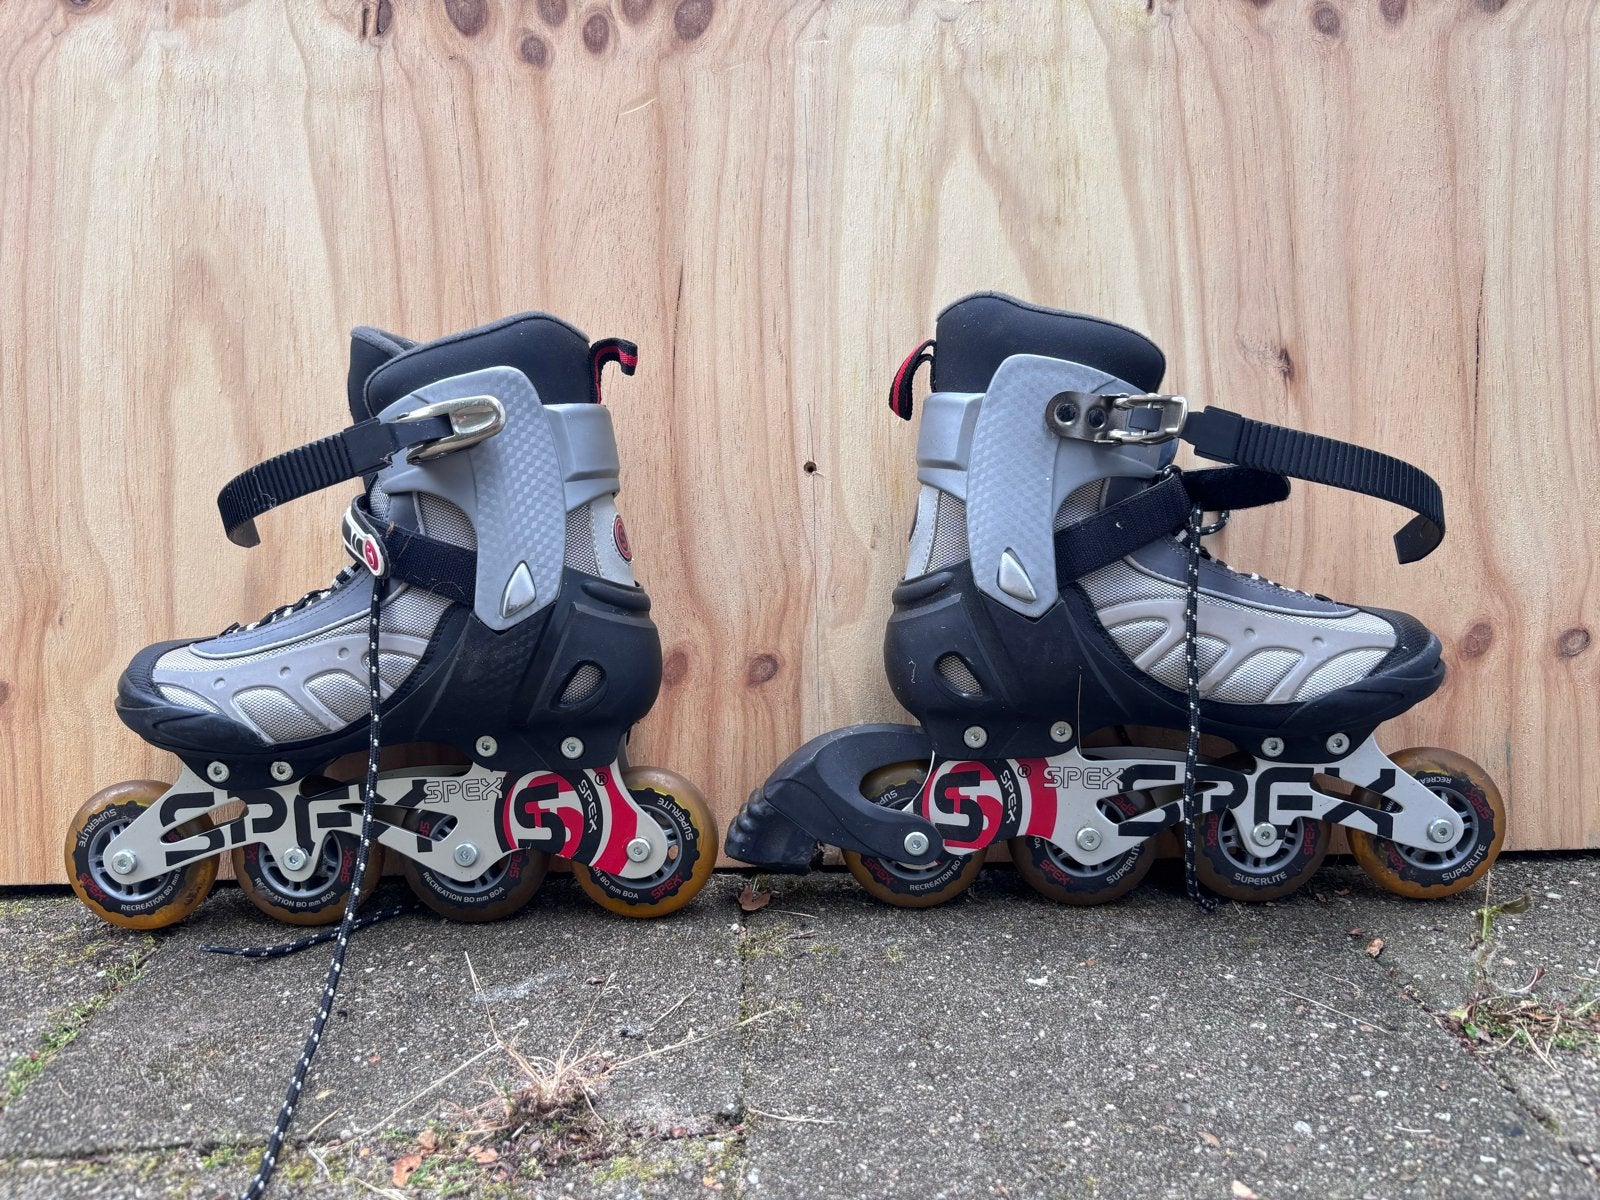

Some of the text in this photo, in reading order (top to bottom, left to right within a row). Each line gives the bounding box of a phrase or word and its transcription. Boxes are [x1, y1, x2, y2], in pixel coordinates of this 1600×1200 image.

[423, 777, 504, 804] SPEX
[1042, 766, 1127, 790] SPEX
[577, 778, 599, 834] SPEX
[1000, 769, 1017, 824] SPEX
[1112, 795, 1137, 816] SPE
[78, 808, 118, 848] SUPERLITE
[657, 797, 694, 841] SUPERLITE
[1303, 822, 1316, 856] SPEX
[340, 848, 354, 884] SPEX
[509, 852, 524, 879] SPE
[863, 858, 894, 885] SPEX
[1040, 859, 1070, 886] SPEX
[1442, 843, 1487, 881] SUPERLITE
[80, 872, 108, 901] SPEX
[422, 871, 463, 902] RECREATION
[651, 873, 683, 899] SPEX
[909, 870, 954, 891] RECREATION
[1233, 871, 1288, 886] SUPERLITE
[120, 893, 165, 911] RECREATION
